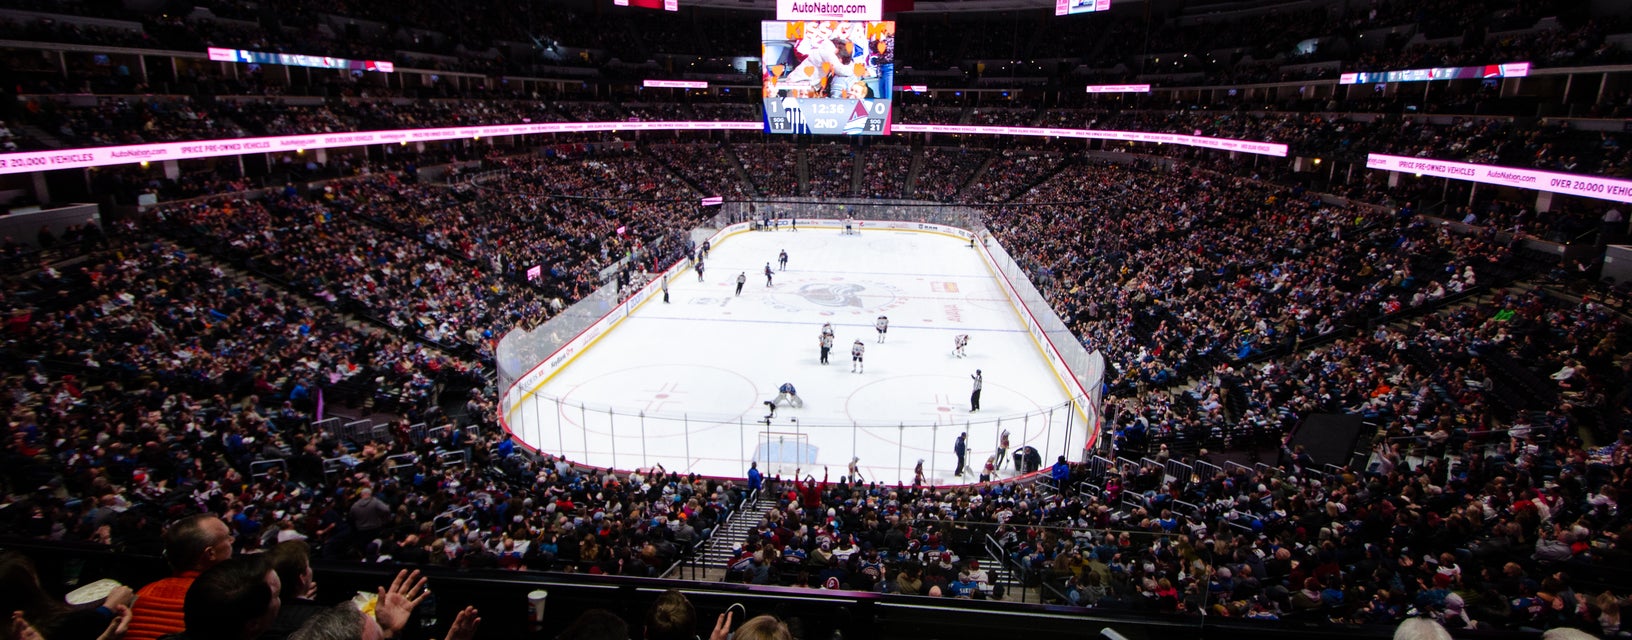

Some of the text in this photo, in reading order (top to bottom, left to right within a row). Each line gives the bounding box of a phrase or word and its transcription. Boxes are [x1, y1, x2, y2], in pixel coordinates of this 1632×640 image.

[791, 2, 867, 14] AutoNation.com
[771, 101, 778, 113] 1
[812, 104, 845, 114] 12:36
[874, 103, 886, 115] 0
[774, 122, 784, 130] 11
[814, 118, 838, 129] 2ND
[870, 123, 881, 131] 21
[111, 148, 168, 158] AutoNation.com
[10, 156, 46, 168] 20,000
[49, 153, 94, 164] VEHICLES
[1447, 166, 1476, 176] VEHICLES
[1486, 170, 1536, 181] AutoNation.com
[1550, 177, 1572, 189] OVER
[1573, 180, 1604, 193] 20,000
